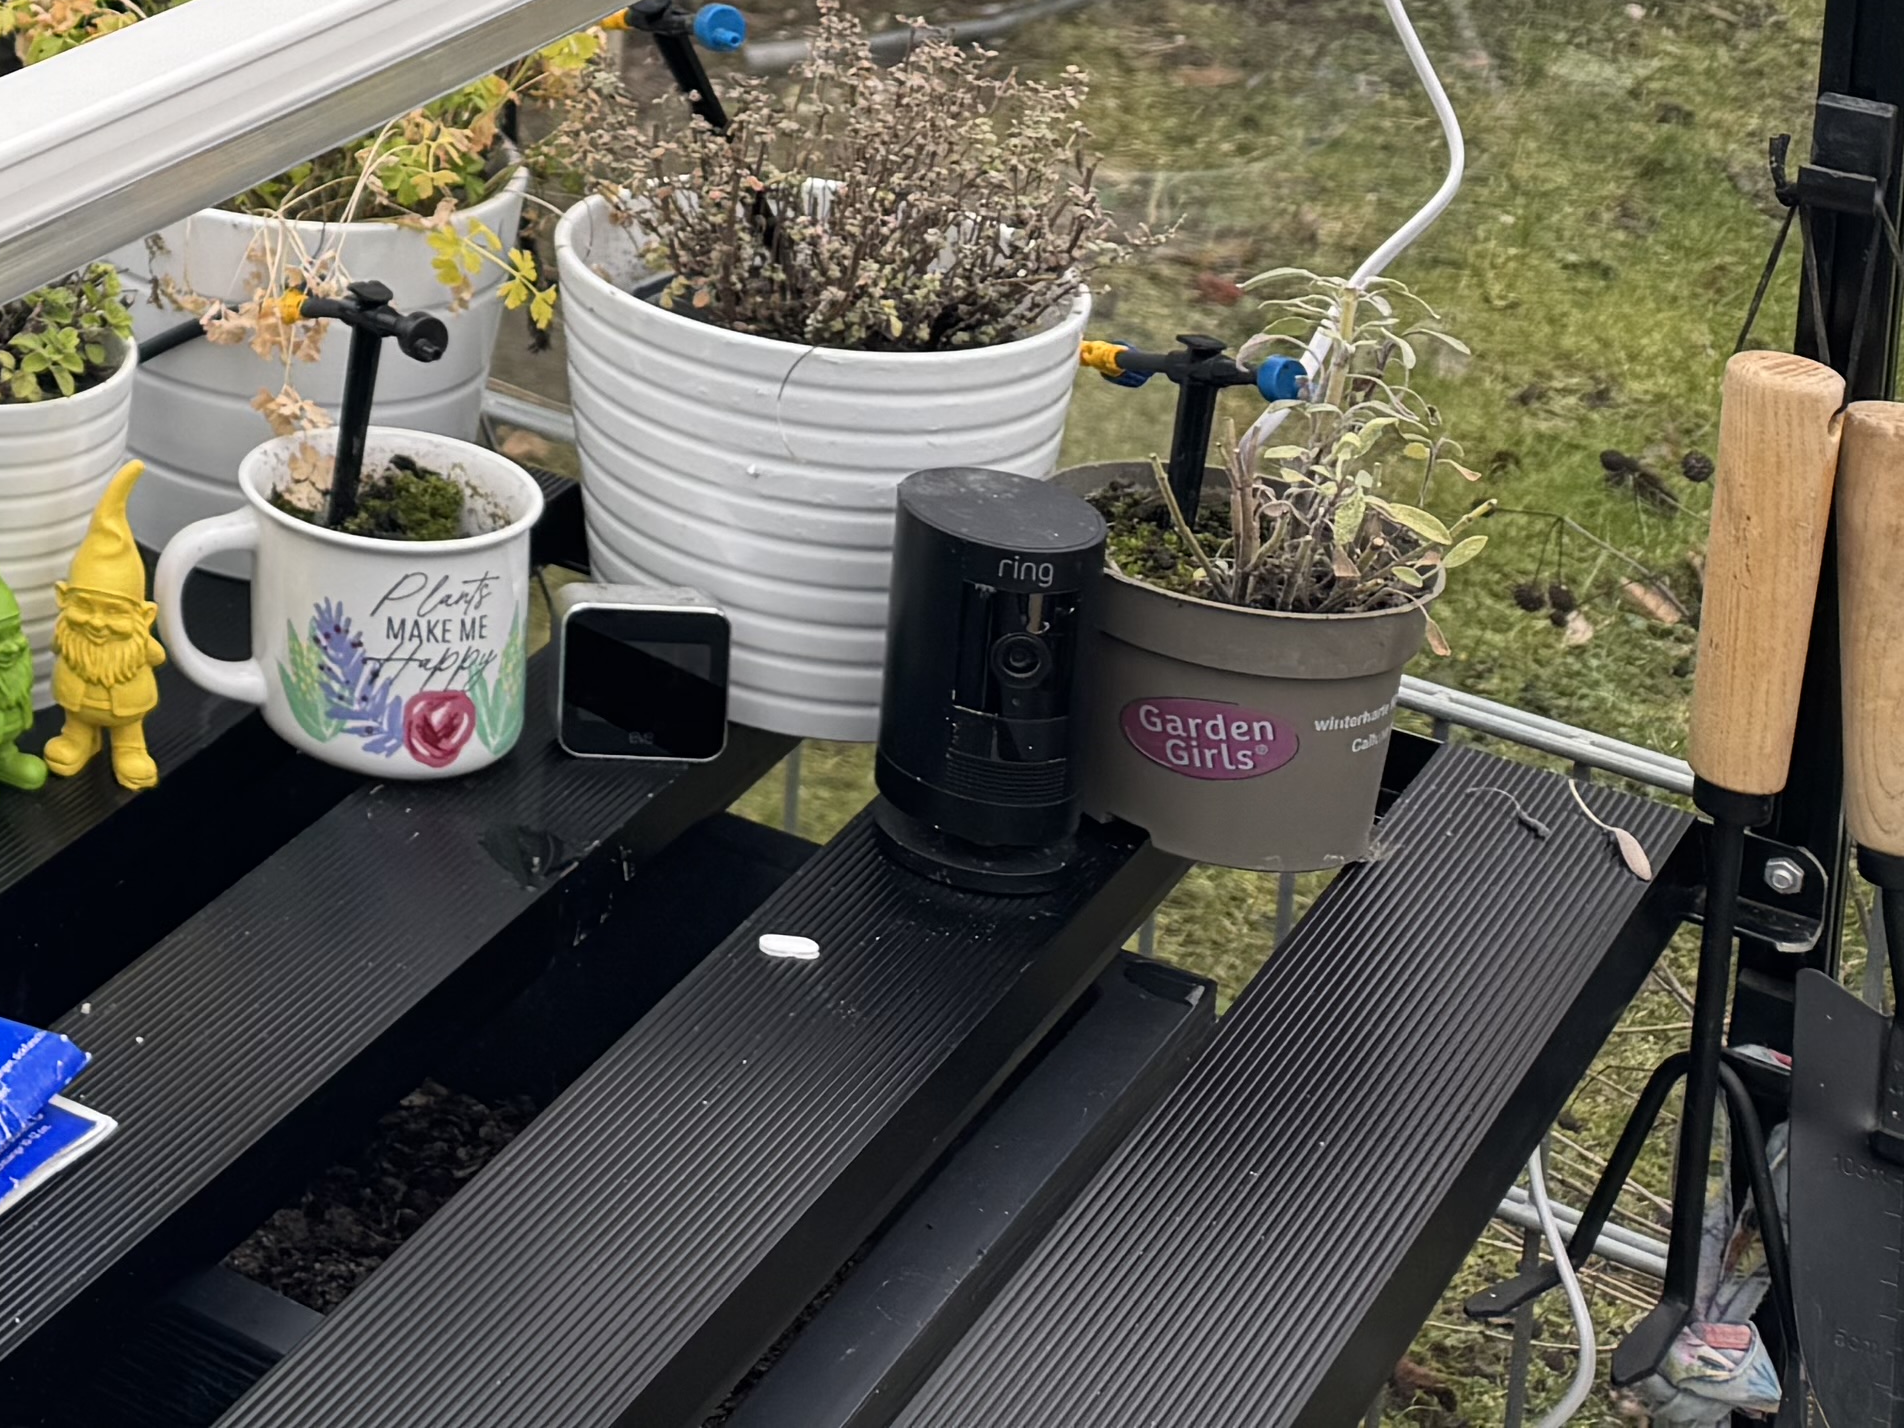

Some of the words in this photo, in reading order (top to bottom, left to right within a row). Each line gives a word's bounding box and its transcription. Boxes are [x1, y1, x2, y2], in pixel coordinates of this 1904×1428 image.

[997, 556, 1055, 588] ring
[370, 571, 500, 617] Plants
[386, 616, 452, 643] MAKE
[460, 614, 488, 642] ME
[363, 643, 498, 693] Happy
[1139, 705, 1275, 741] Garden
